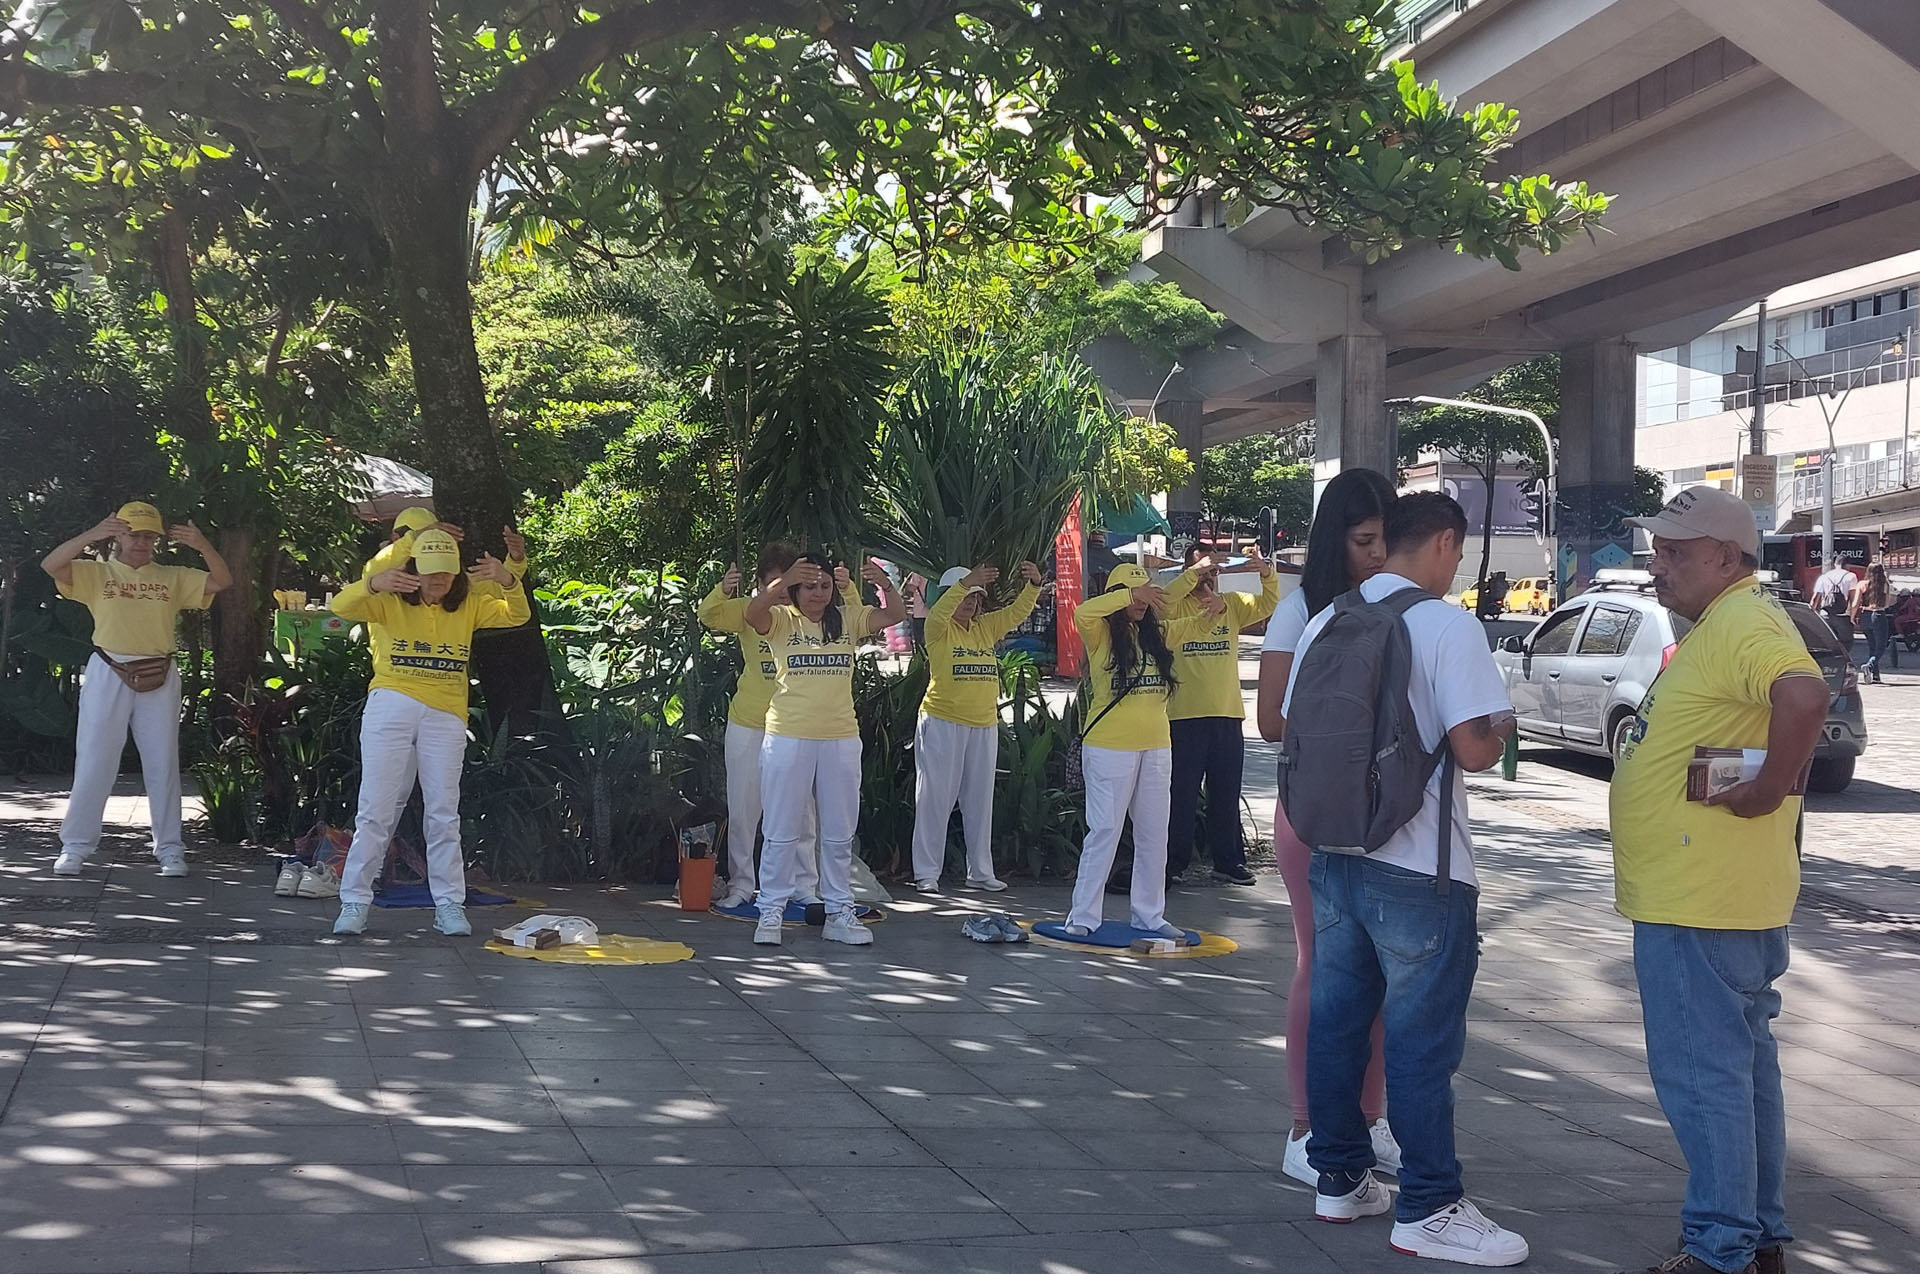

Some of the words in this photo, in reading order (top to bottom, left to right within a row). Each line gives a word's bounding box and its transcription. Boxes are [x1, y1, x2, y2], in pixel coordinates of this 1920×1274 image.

[1810, 550, 1841, 559] SAA
[1184, 642, 1209, 651] FALUN
[788, 655, 825, 667] FALUN
